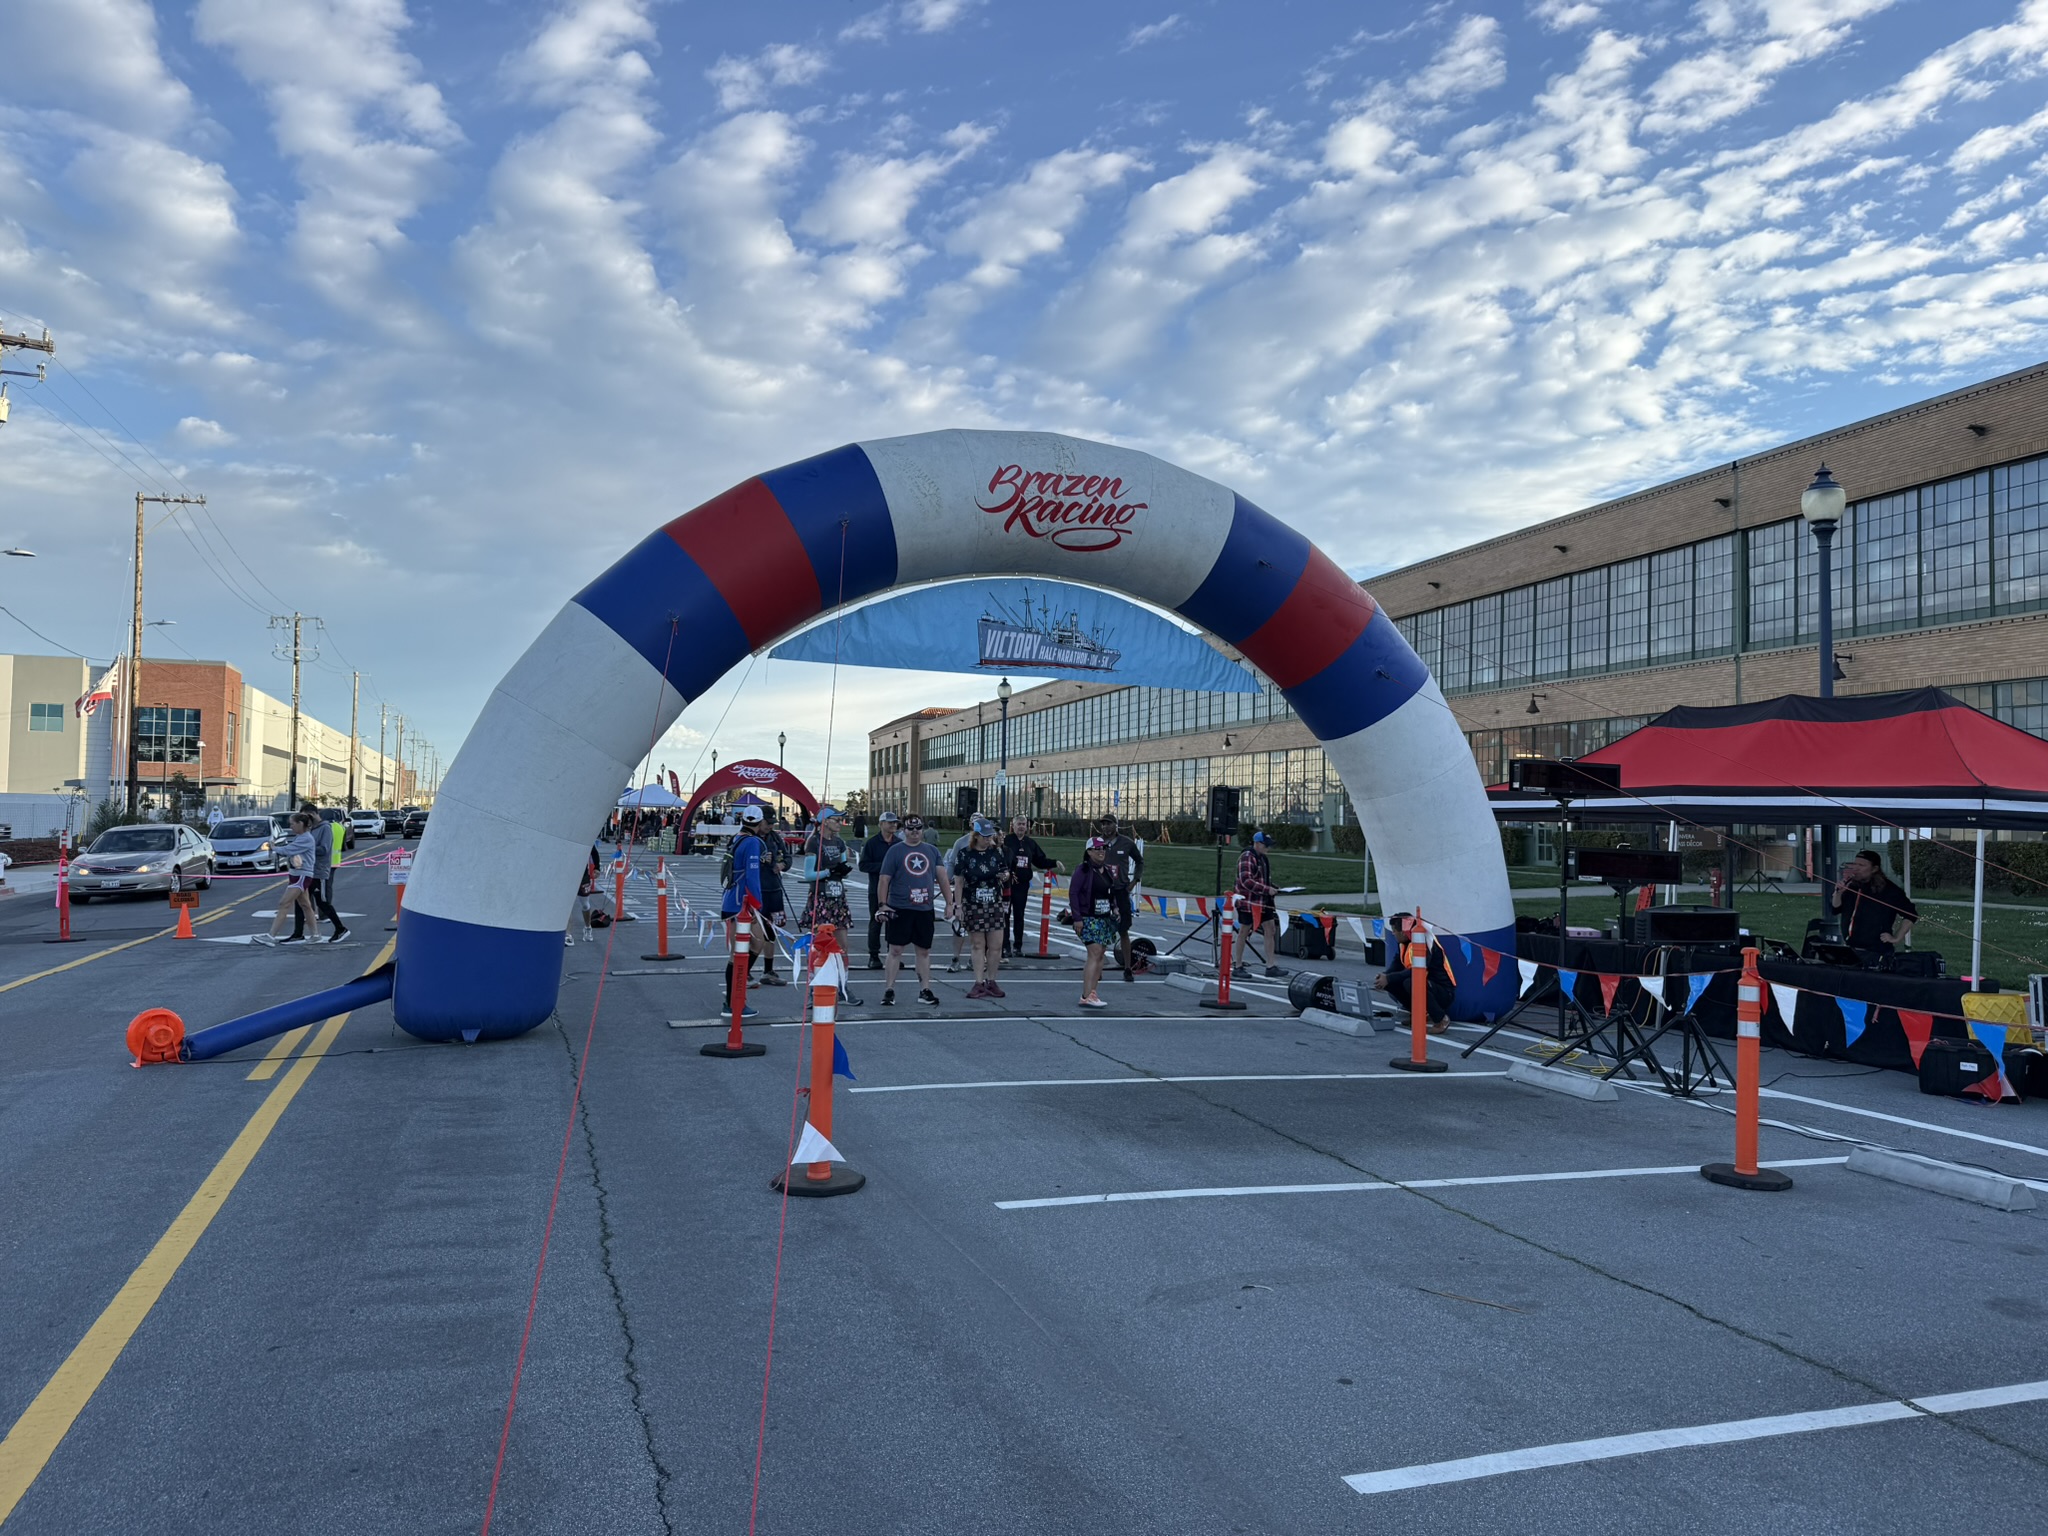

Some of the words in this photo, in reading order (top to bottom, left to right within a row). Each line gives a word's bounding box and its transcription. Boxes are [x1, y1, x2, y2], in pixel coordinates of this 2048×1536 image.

[974, 464, 1132, 513] Brazen
[1004, 495, 1148, 552] Racing
[984, 629, 1042, 659] VICTORY
[1038, 645, 1058, 662] HALF
[729, 764, 776, 774] Brazen
[738, 770, 782, 784] Racing
